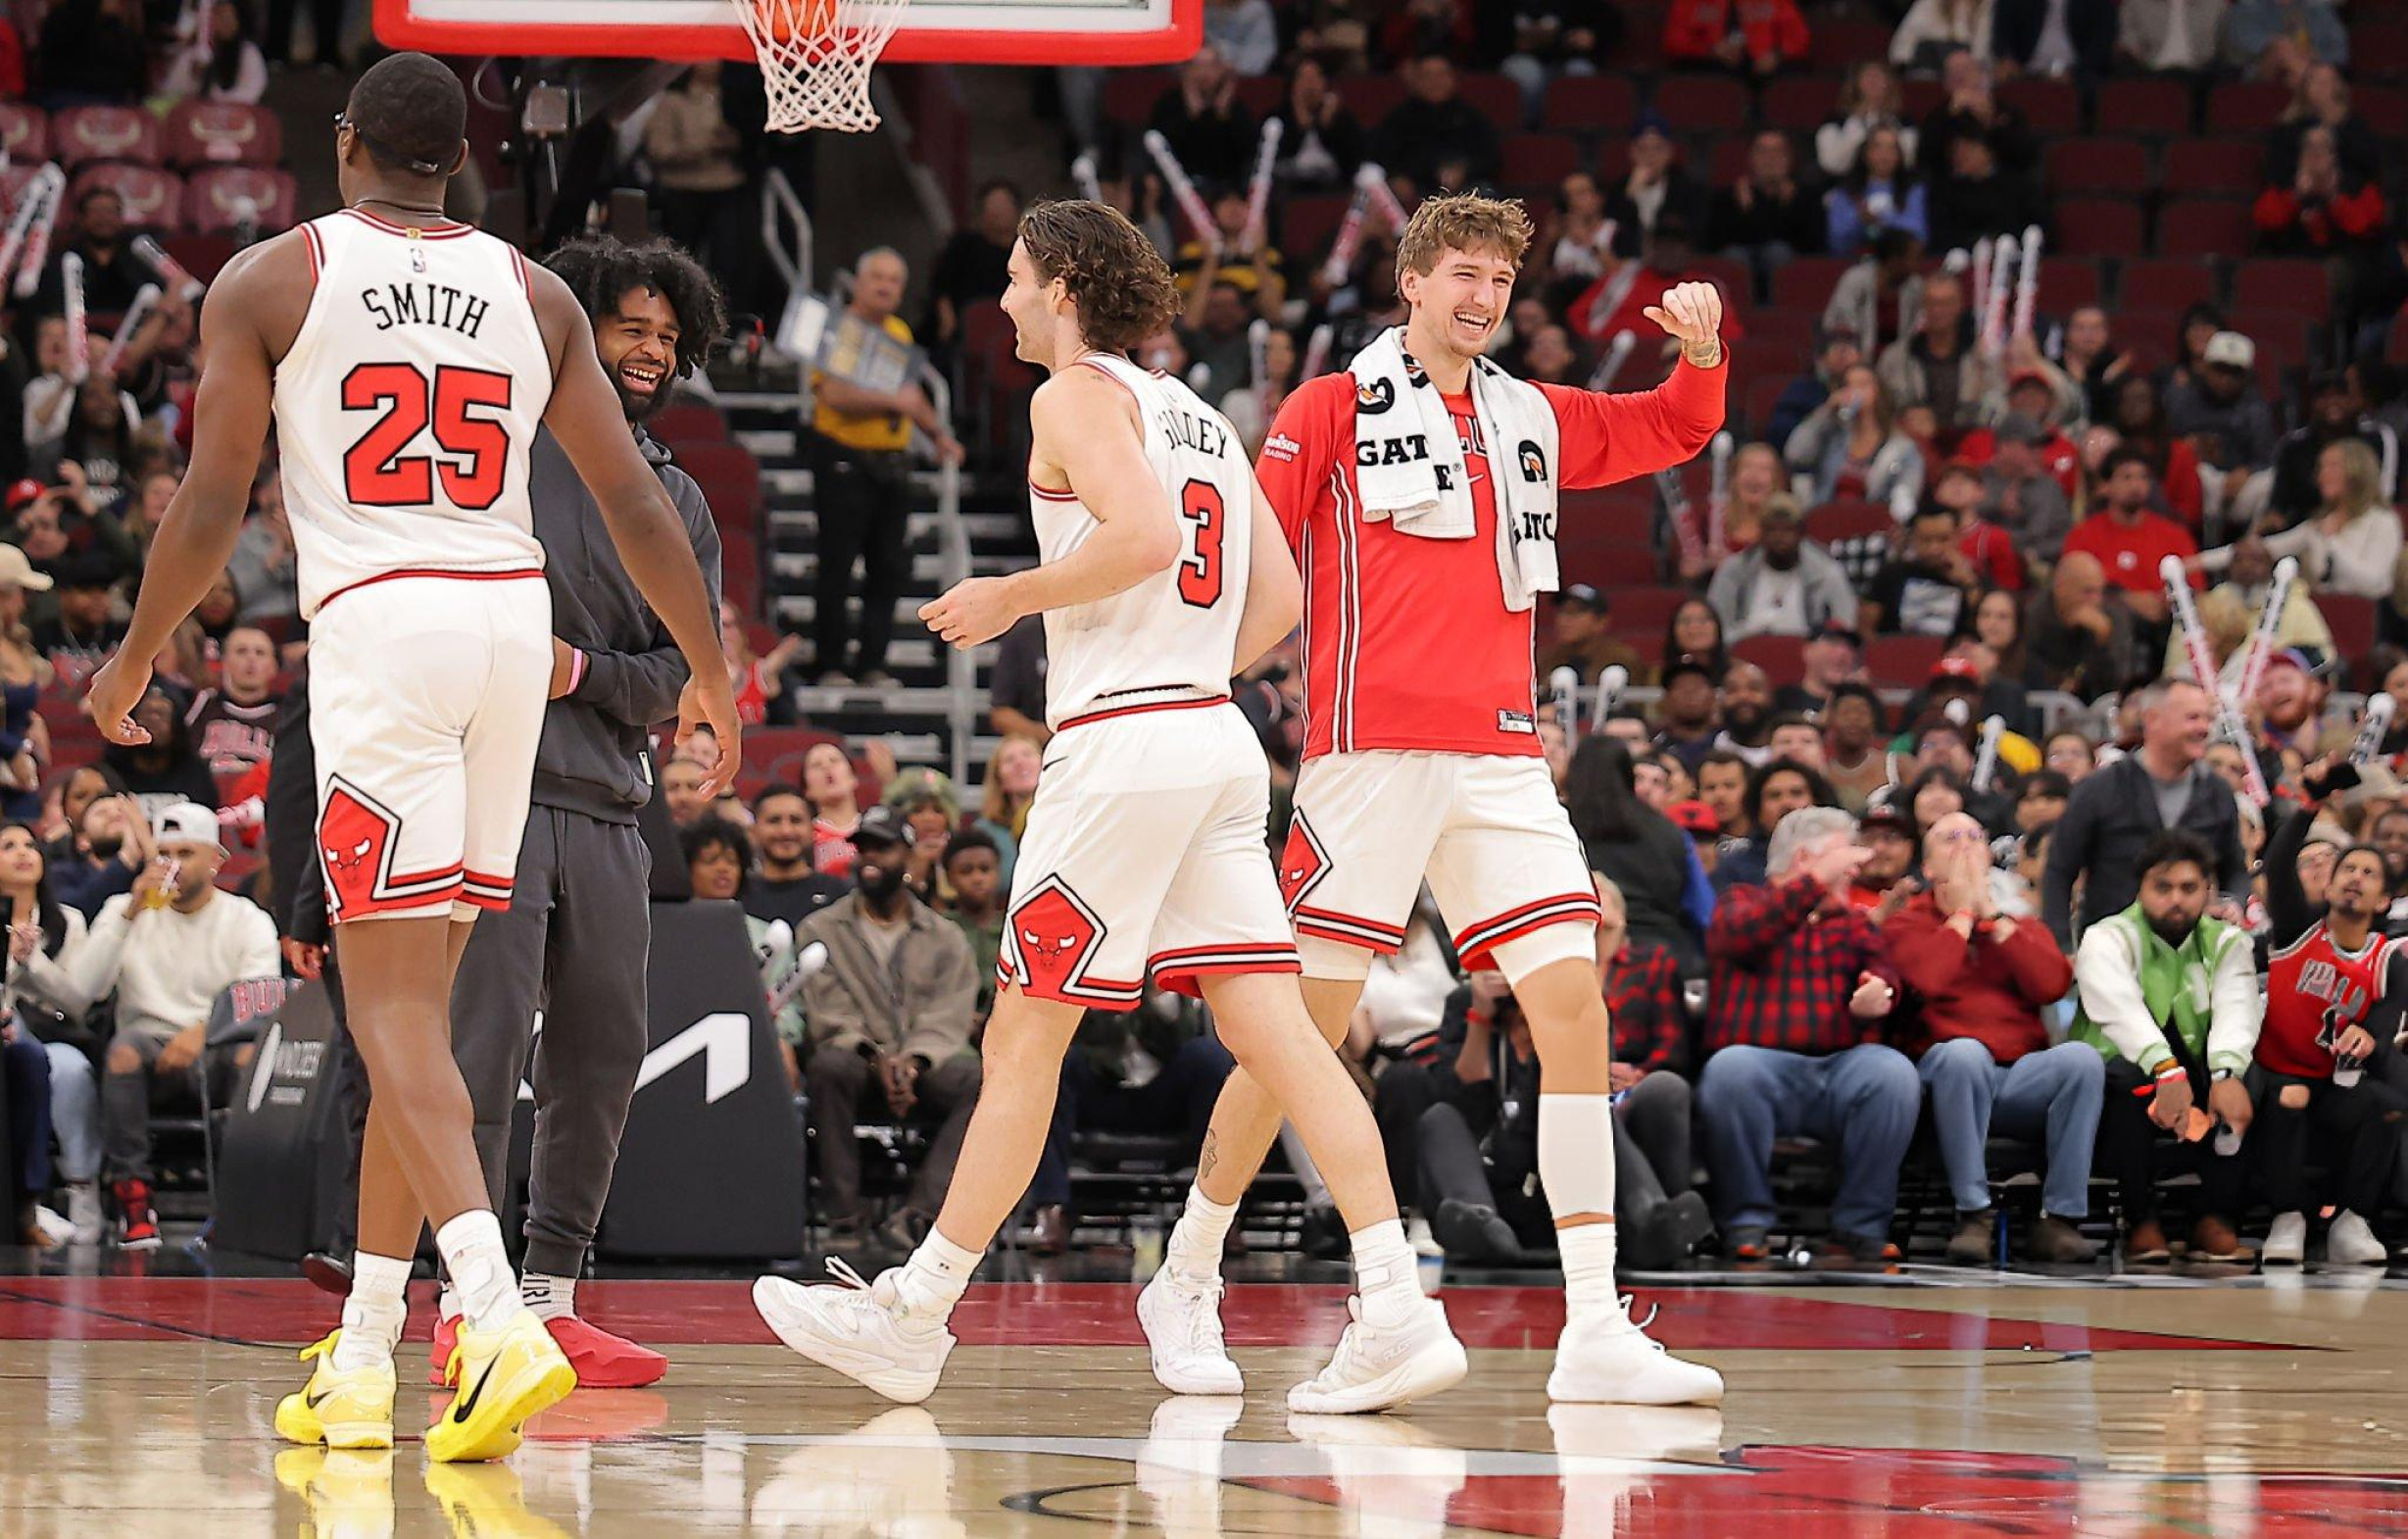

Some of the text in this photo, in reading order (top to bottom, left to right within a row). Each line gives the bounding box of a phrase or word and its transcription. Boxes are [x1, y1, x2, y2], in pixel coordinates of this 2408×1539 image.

[362, 282, 490, 339] SMITH
[341, 362, 513, 511] 25
[1177, 477, 1224, 610] 3
